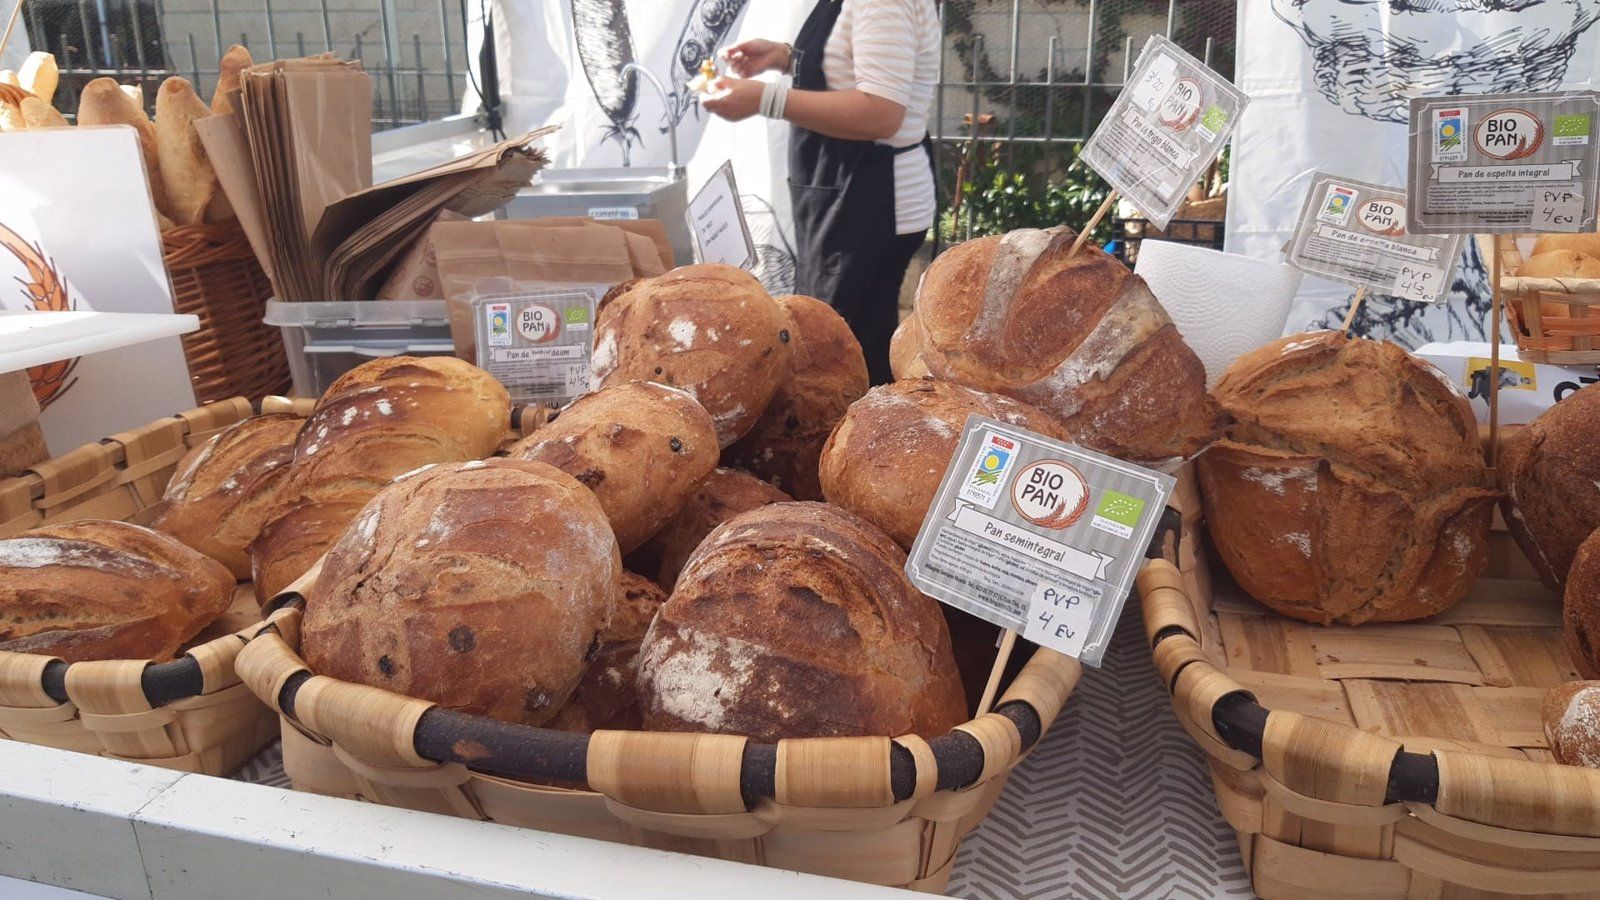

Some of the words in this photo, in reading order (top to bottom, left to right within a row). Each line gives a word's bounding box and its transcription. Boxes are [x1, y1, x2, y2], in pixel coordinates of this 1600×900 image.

[1174, 83, 1192, 101] BIO
[1164, 95, 1186, 115] PAN
[1488, 119, 1517, 133] BIO
[1147, 130, 1162, 145] trigo
[1160, 140, 1179, 159] blanco
[1486, 133, 1518, 146] PAN
[1458, 170, 1472, 179] Pan
[1474, 170, 1485, 178] de
[1487, 169, 1516, 179] espelta
[1518, 168, 1550, 178] integral
[1544, 191, 1573, 203] PVP
[1369, 203, 1394, 216] BIO
[1365, 213, 1392, 226] PAN
[1331, 229, 1347, 239] Pan
[1391, 244, 1417, 255] blanca
[1402, 267, 1432, 281] PVP
[523, 311, 542, 321] BIO
[523, 322, 545, 332] PAN
[506, 351, 519, 359] Pan
[521, 350, 530, 358] de
[1029, 467, 1064, 491] BIO
[1020, 483, 1059, 510] PAN
[984, 521, 1003, 539] Pan
[1003, 533, 1066, 562] semintegral
[1044, 588, 1080, 609] PVP
[1039, 611, 1054, 630] 4
